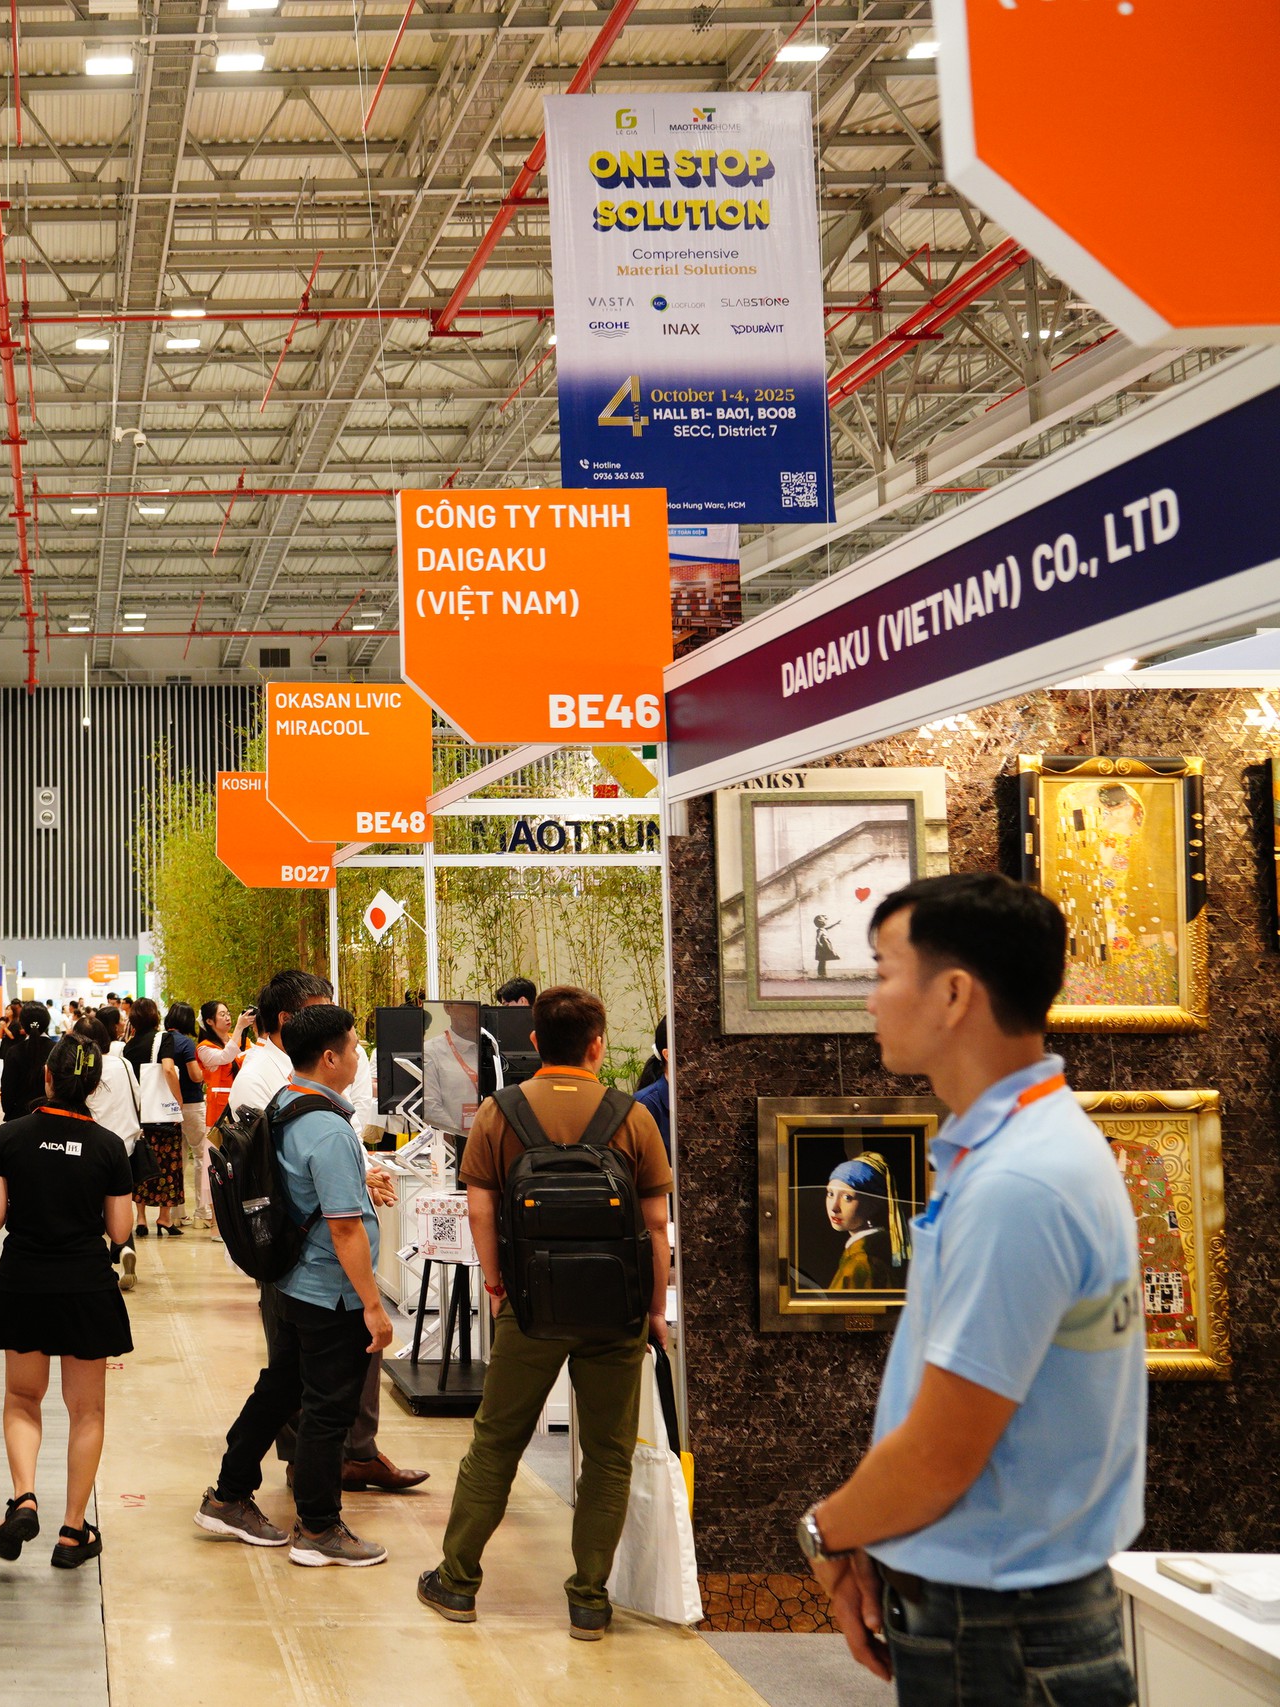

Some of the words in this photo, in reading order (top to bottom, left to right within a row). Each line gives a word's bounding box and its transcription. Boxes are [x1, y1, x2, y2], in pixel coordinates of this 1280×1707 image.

[589, 150, 670, 189] ONE
[673, 148, 775, 188] STOP
[593, 198, 770, 232] SOLUTION
[632, 248, 739, 261] Comprehensive
[616, 264, 679, 276] Material
[684, 263, 757, 275] Solutions
[588, 297, 635, 307] VASTA
[589, 321, 630, 329] GROHE
[663, 323, 701, 335] INAX
[745, 322, 784, 334] DURAVIT
[650, 388, 714, 402] October
[721, 388, 749, 403] 1-4,
[754, 388, 795, 402] 2025
[598, 375, 649, 437] 4
[653, 408, 687, 420] HALL
[691, 408, 712, 420] B1-
[716, 407, 753, 421] BA01,
[673, 425, 715, 438] SECC,
[719, 425, 766, 437] District
[770, 425, 778, 436] 7
[593, 461, 621, 469] Hotline
[615, 472, 629, 480] 363
[631, 472, 644, 480] 633
[683, 502, 702, 510] Hung
[416, 499, 496, 529] CÔNG
[504, 505, 541, 528] TY
[549, 504, 630, 528] TNHH
[417, 547, 546, 571] DAIGAKU
[781, 625, 871, 698] DAIGAKU
[877, 555, 1022, 661] (VIETNAM)
[1032, 533, 1098, 592] CO.,
[1104, 487, 1180, 564] LTD
[416, 586, 493, 621] (VIỆT
[502, 588, 579, 617] NAM)
[275, 693, 351, 709] OKASAN
[356, 693, 402, 708] LIVIC
[549, 694, 661, 729] BE46
[276, 720, 370, 735] MIRACOOL
[222, 778, 261, 790] KOSHI
[356, 811, 425, 833] BE48
[39, 1141, 65, 1151] AICA
